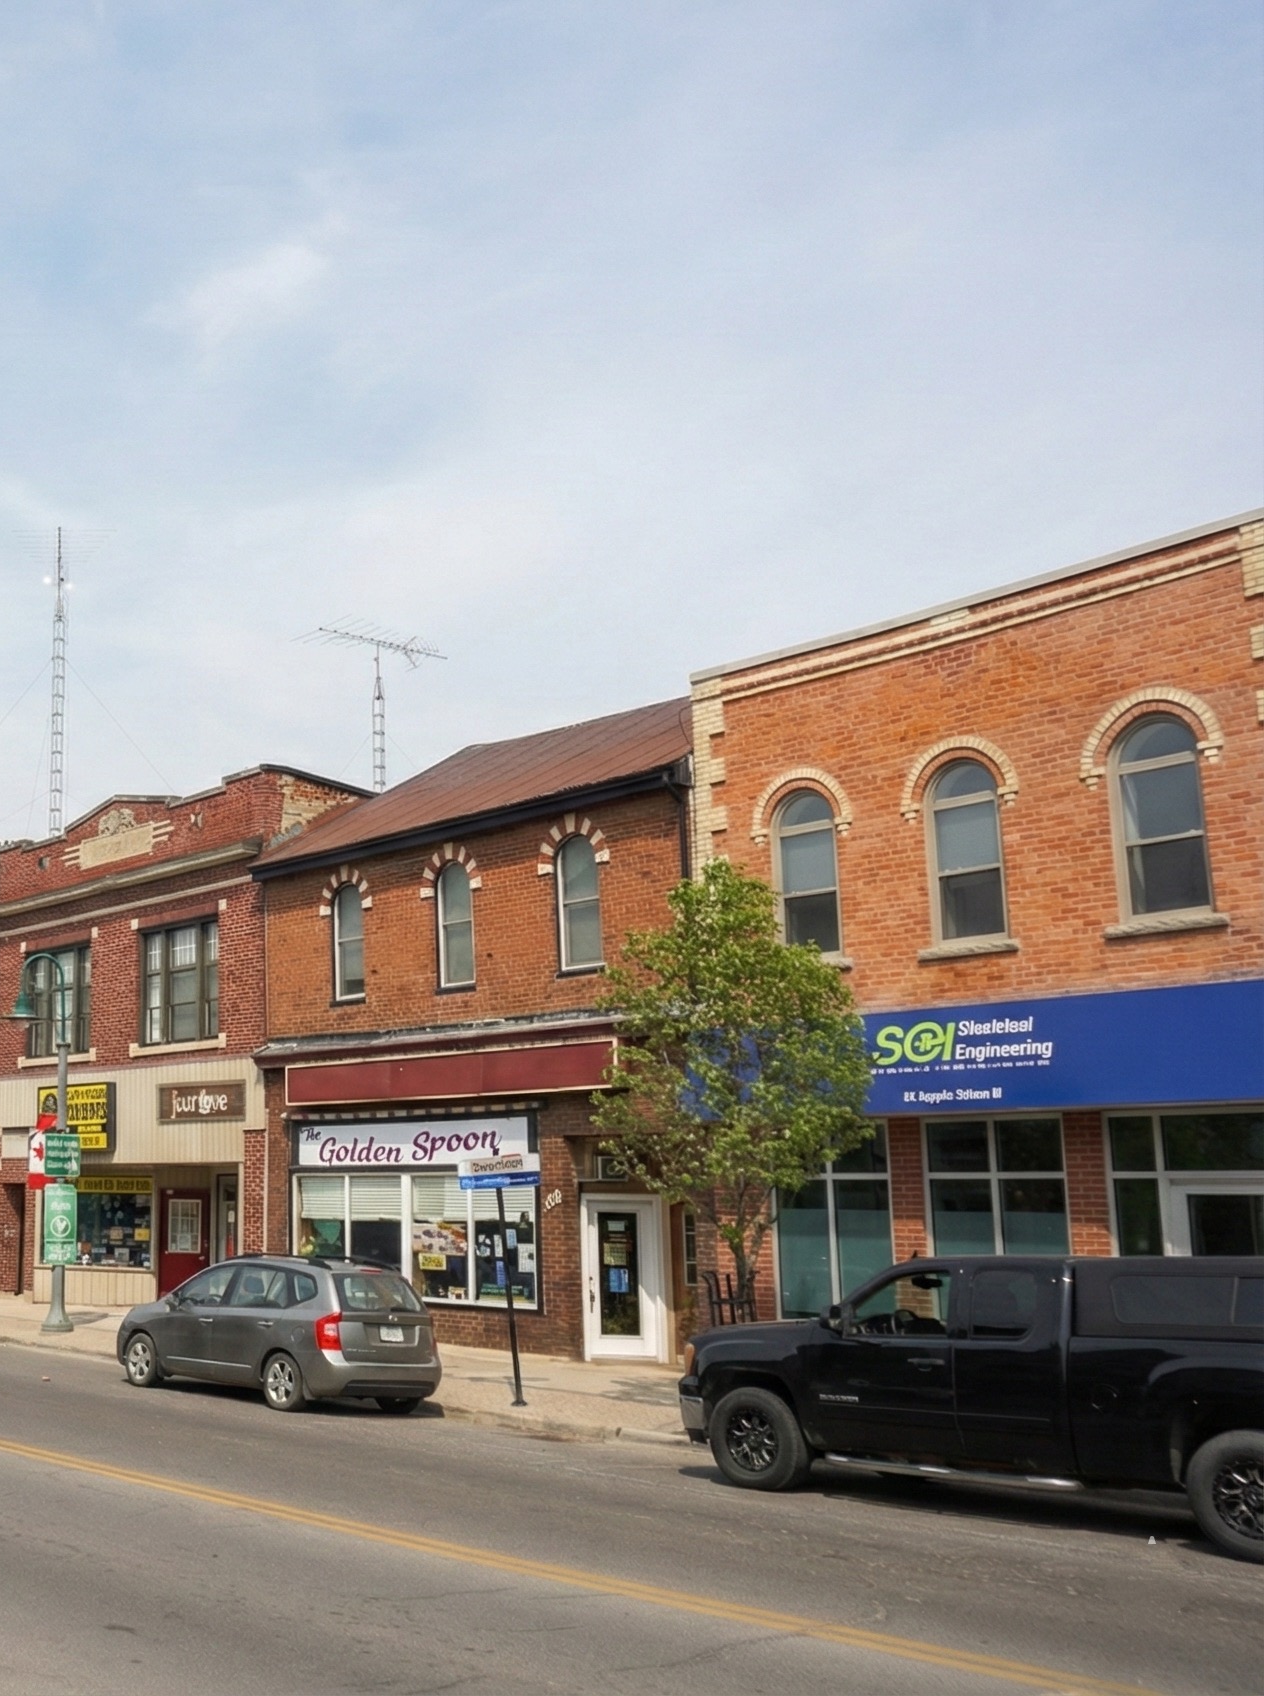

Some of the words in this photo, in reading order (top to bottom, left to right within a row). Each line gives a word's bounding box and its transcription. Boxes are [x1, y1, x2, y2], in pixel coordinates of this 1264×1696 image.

[955, 1039, 1053, 1062] Engineering
[301, 1127, 322, 1141] The
[319, 1136, 404, 1166] Golden
[411, 1129, 503, 1162] Spoon
